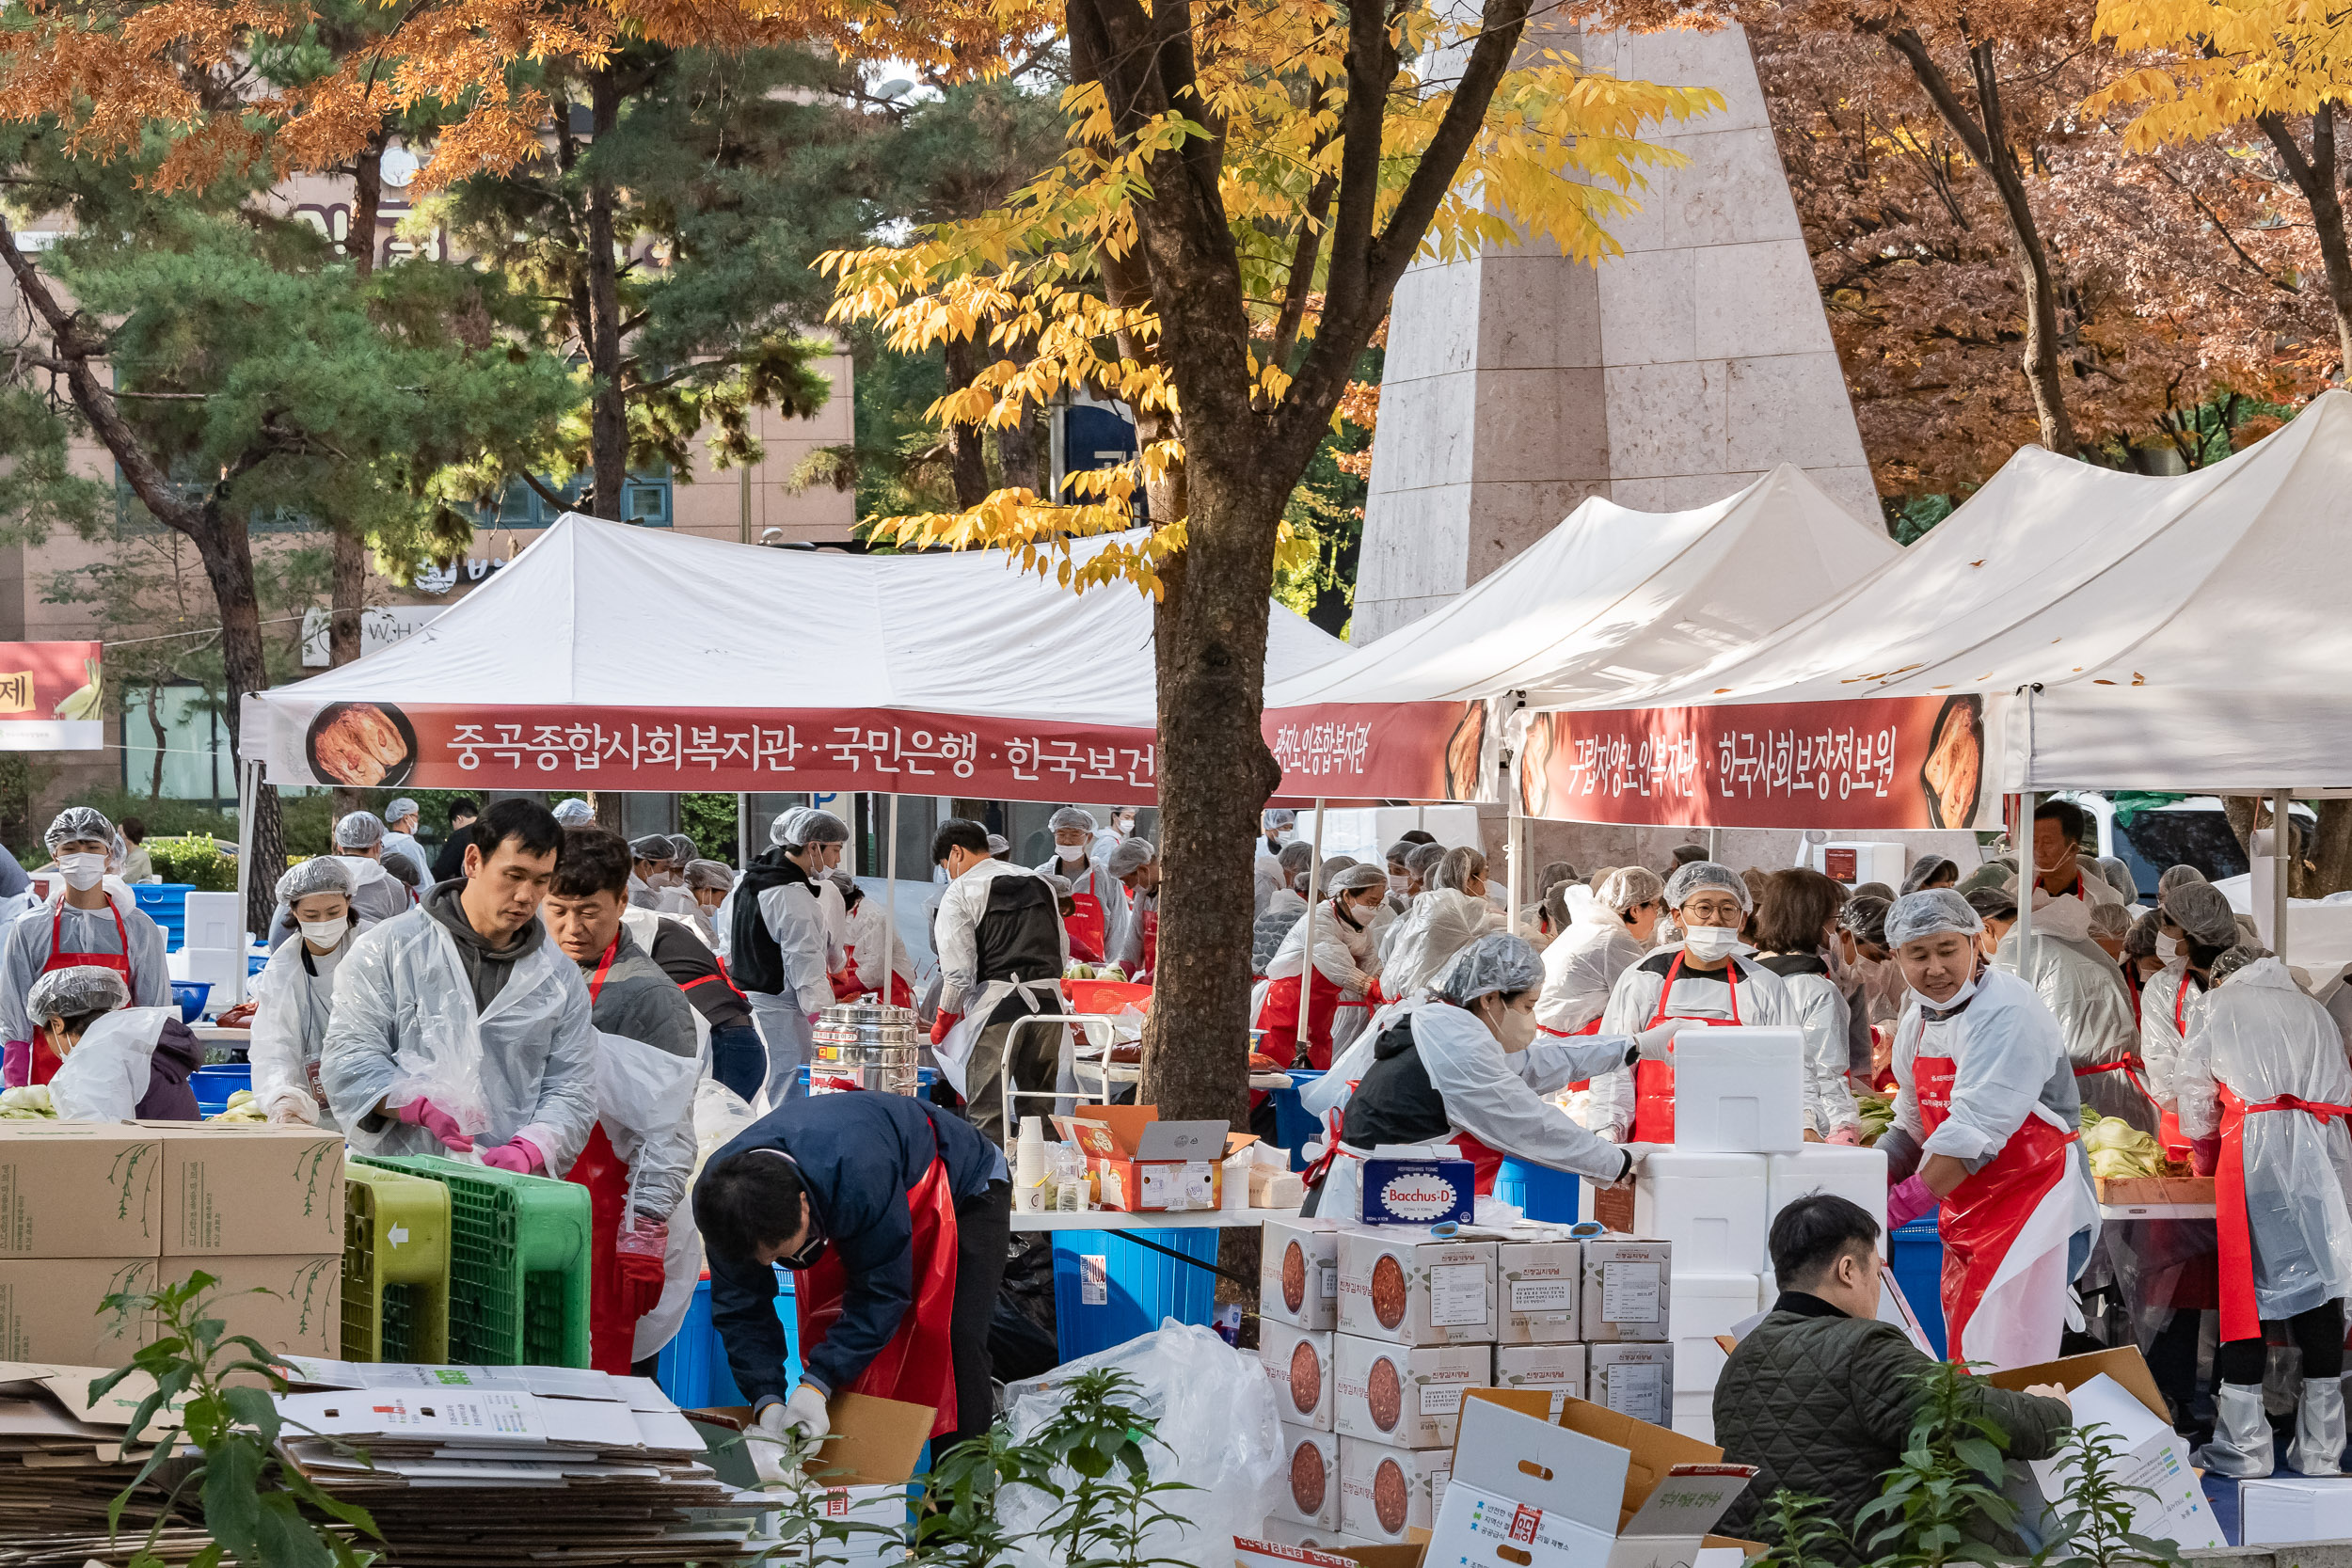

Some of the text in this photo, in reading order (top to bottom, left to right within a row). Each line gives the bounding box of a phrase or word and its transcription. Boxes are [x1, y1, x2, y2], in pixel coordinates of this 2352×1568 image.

[447, 722, 803, 772] 중곡종합사회복지관
[825, 726, 977, 779] 국민은행
[1718, 725, 1897, 800] 한국사회보장정보원
